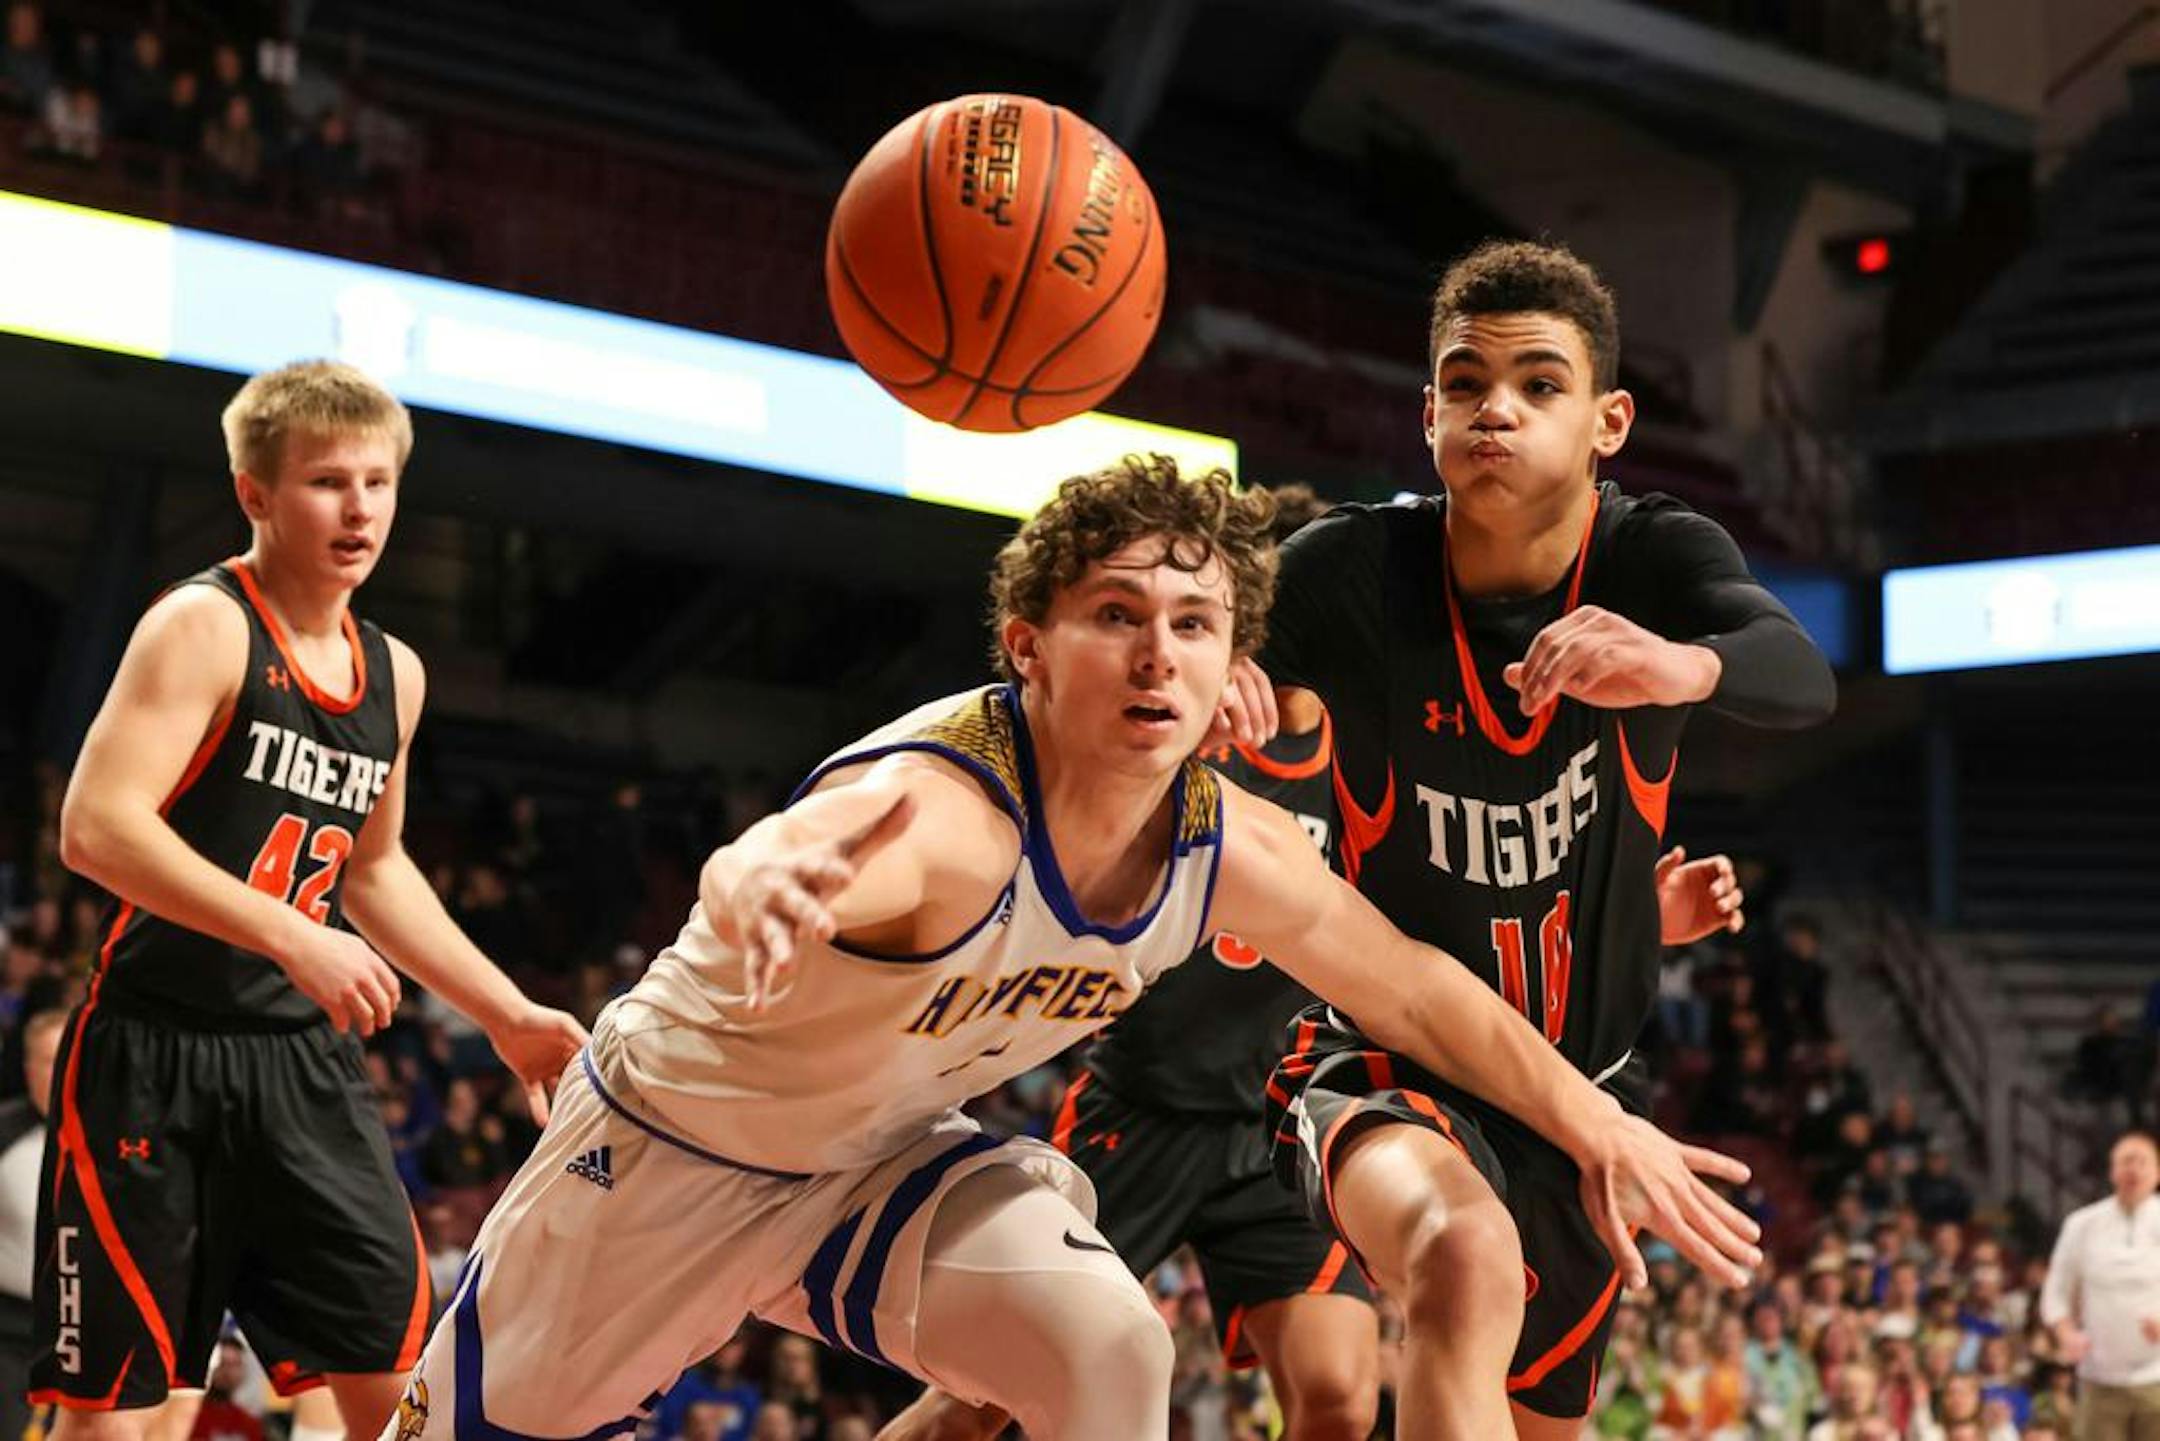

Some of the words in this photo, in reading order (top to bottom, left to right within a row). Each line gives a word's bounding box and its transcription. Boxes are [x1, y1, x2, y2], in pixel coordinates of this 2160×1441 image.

[983, 99, 1021, 226] EGACY
[247, 813, 353, 926] 42
[902, 964, 1126, 1038] HYFIEL
[1491, 889, 1573, 1046] 10
[55, 1226, 82, 1375] CHS
